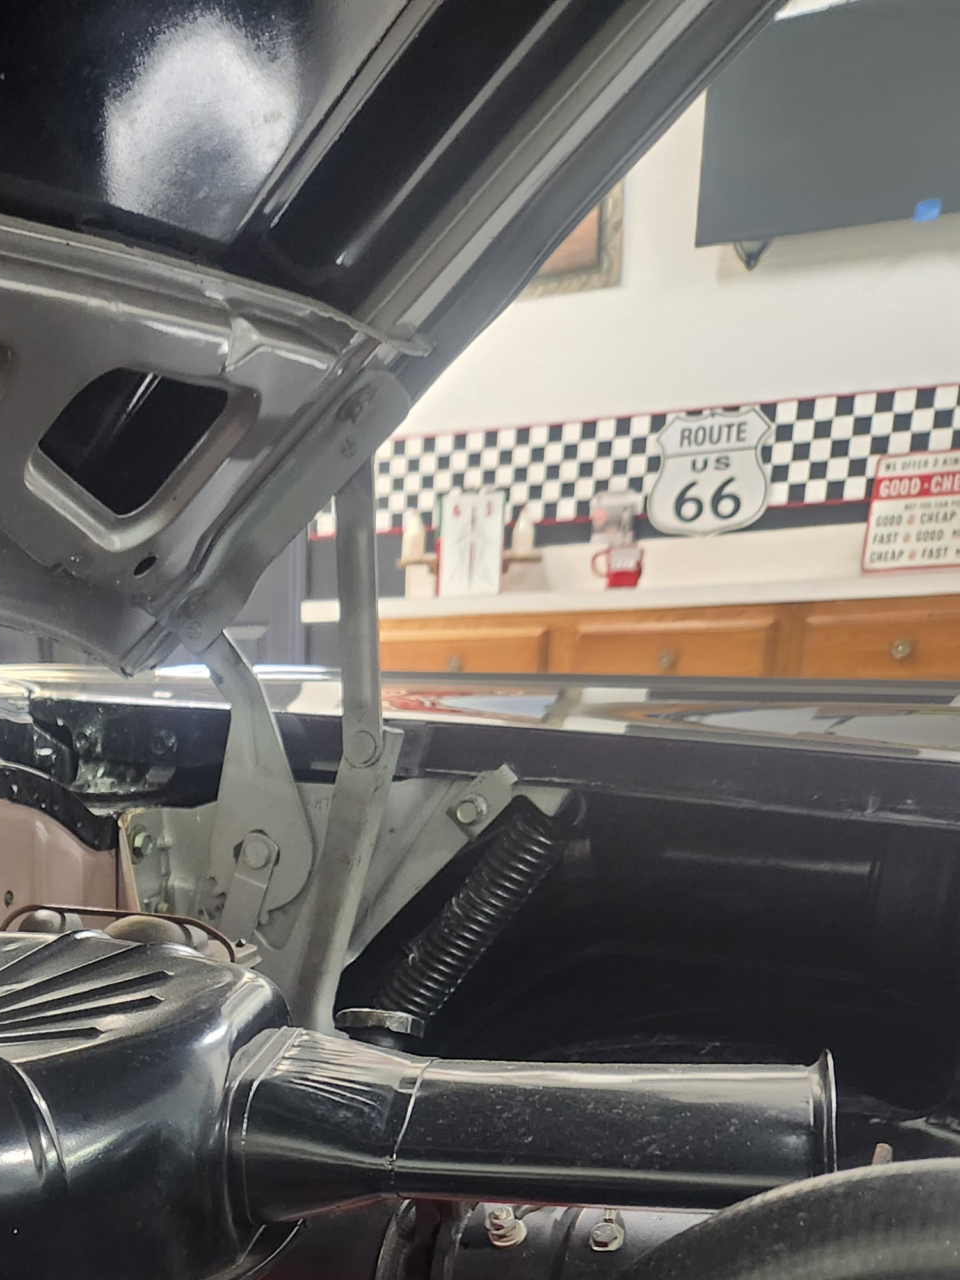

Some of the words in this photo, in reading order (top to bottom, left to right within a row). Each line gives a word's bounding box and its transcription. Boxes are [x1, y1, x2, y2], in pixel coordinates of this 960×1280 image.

[680, 421, 747, 447] ROUTE
[691, 456, 730, 473] US
[879, 477, 921, 498] GOOD
[674, 476, 740, 522] 66
[919, 510, 957, 525] CHEAP
[871, 532, 899, 545] FAST
[915, 529, 944, 543] GOOD
[869, 549, 904, 564] CHEAP
[921, 546, 948, 559] FAST
